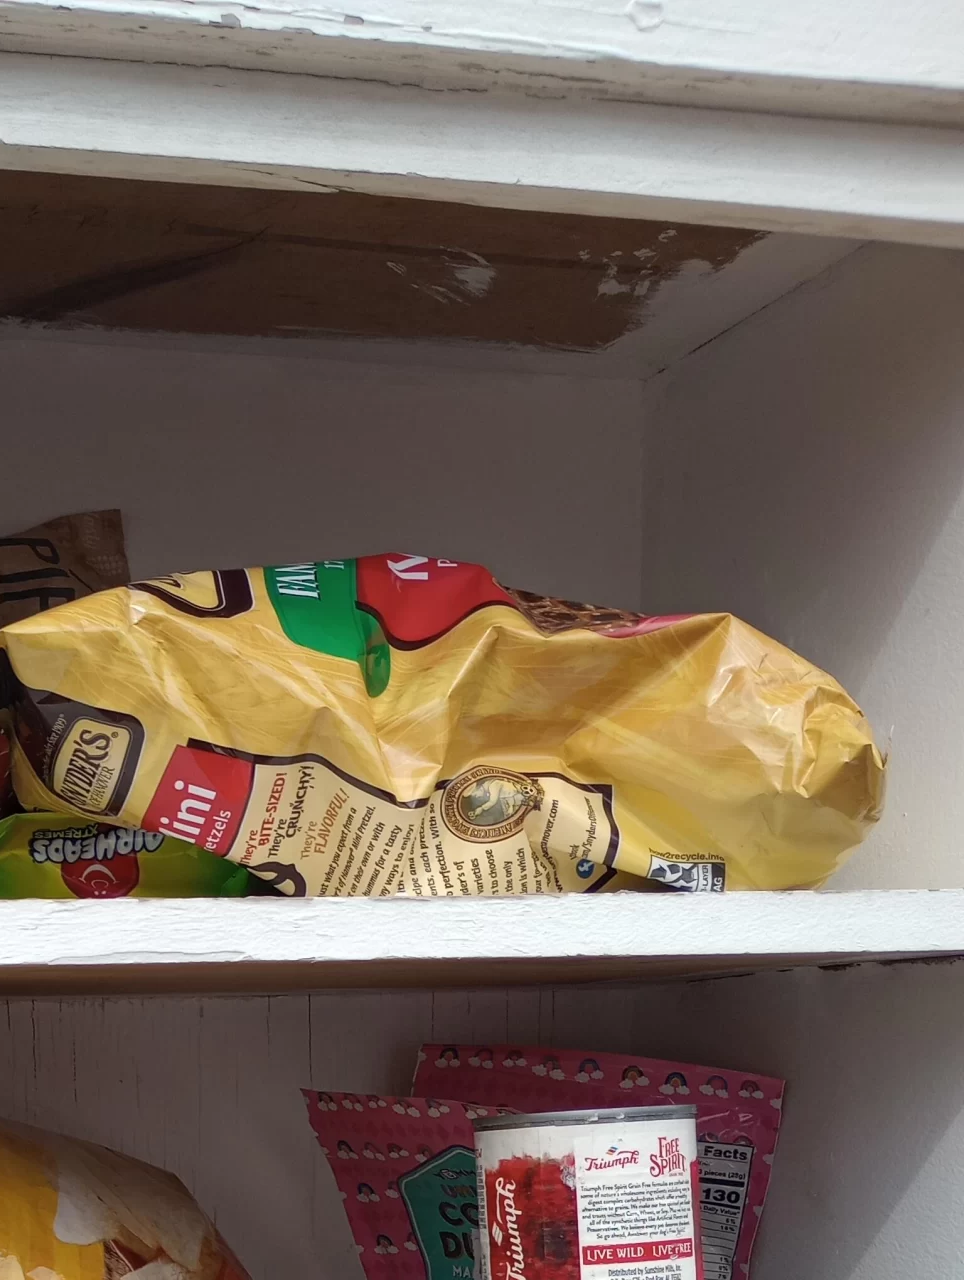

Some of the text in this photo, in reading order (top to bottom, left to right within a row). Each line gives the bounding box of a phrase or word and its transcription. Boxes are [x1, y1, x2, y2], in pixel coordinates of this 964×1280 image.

[60, 729, 112, 806] SNYDER'S
[258, 771, 288, 847] BITE-SIZED!
[286, 764, 315, 840] CRUNCHY!
[34, 823, 100, 840] XTREMES
[313, 788, 353, 855] FLAVORFUL!
[351, 804, 376, 850] Mini Pretzel.
[30, 828, 165, 866] AIRHEADS
[267, 818, 288, 859] They're
[300, 820, 319, 861] They're
[335, 831, 351, 853] expect
[658, 1136, 681, 1159] FREE
[704, 1145, 747, 1161] Facts
[584, 1150, 640, 1173] Triumph
[649, 1155, 687, 1178] SPIRIT
[704, 1170, 726, 1178] pieces
[702, 1188, 740, 1204] 130
[587, 1244, 674, 1262] LIVE WILD LIVE
[608, 1265, 665, 1278] Distributed Sunshine
